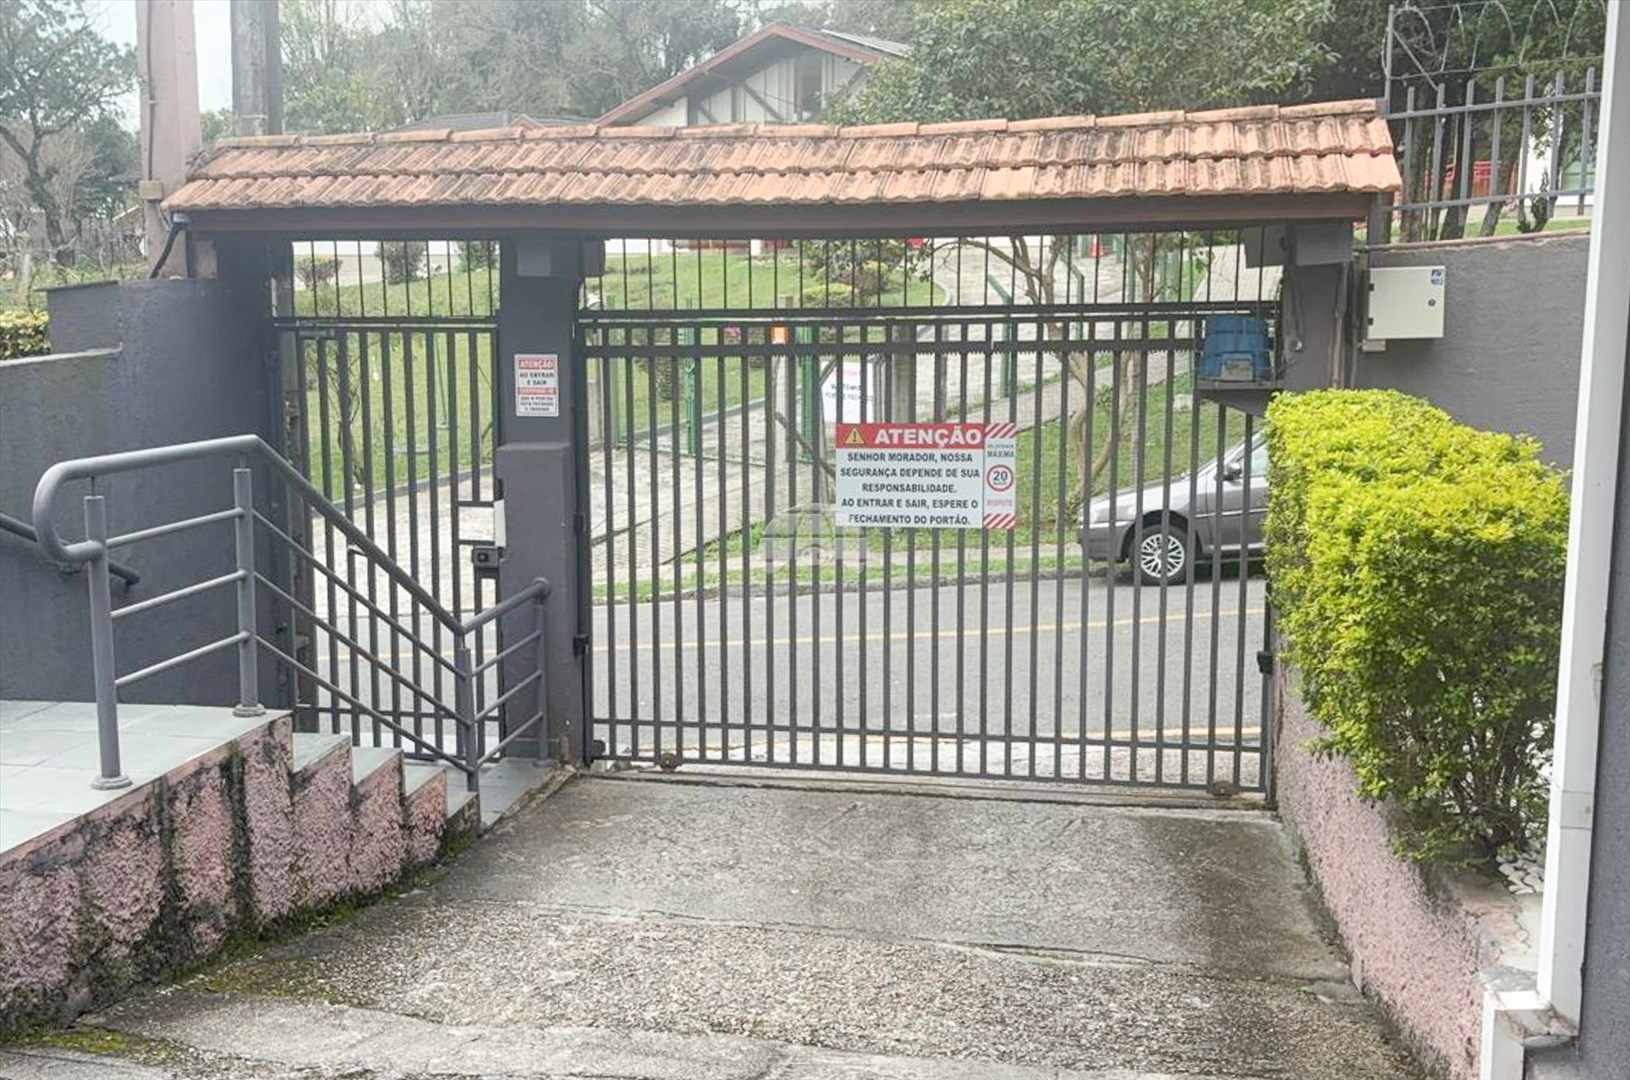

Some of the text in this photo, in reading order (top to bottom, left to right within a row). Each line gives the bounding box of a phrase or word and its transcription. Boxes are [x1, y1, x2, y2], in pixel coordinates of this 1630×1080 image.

[874, 425, 982, 449] ATENÇÃO
[847, 452, 973, 464] SENHOR MORADOR, NOSSA
[840, 467, 980, 479] SEGURANÇA DEPENDE DE SUA
[993, 470, 1008, 481] 20
[861, 483, 957, 493] RESPONSABILIDADE.
[841, 498, 979, 509] AO ENTRAR E SAIR, ESPERE O
[848, 513, 971, 526] FECHAMENTO DO PORTÃO.
